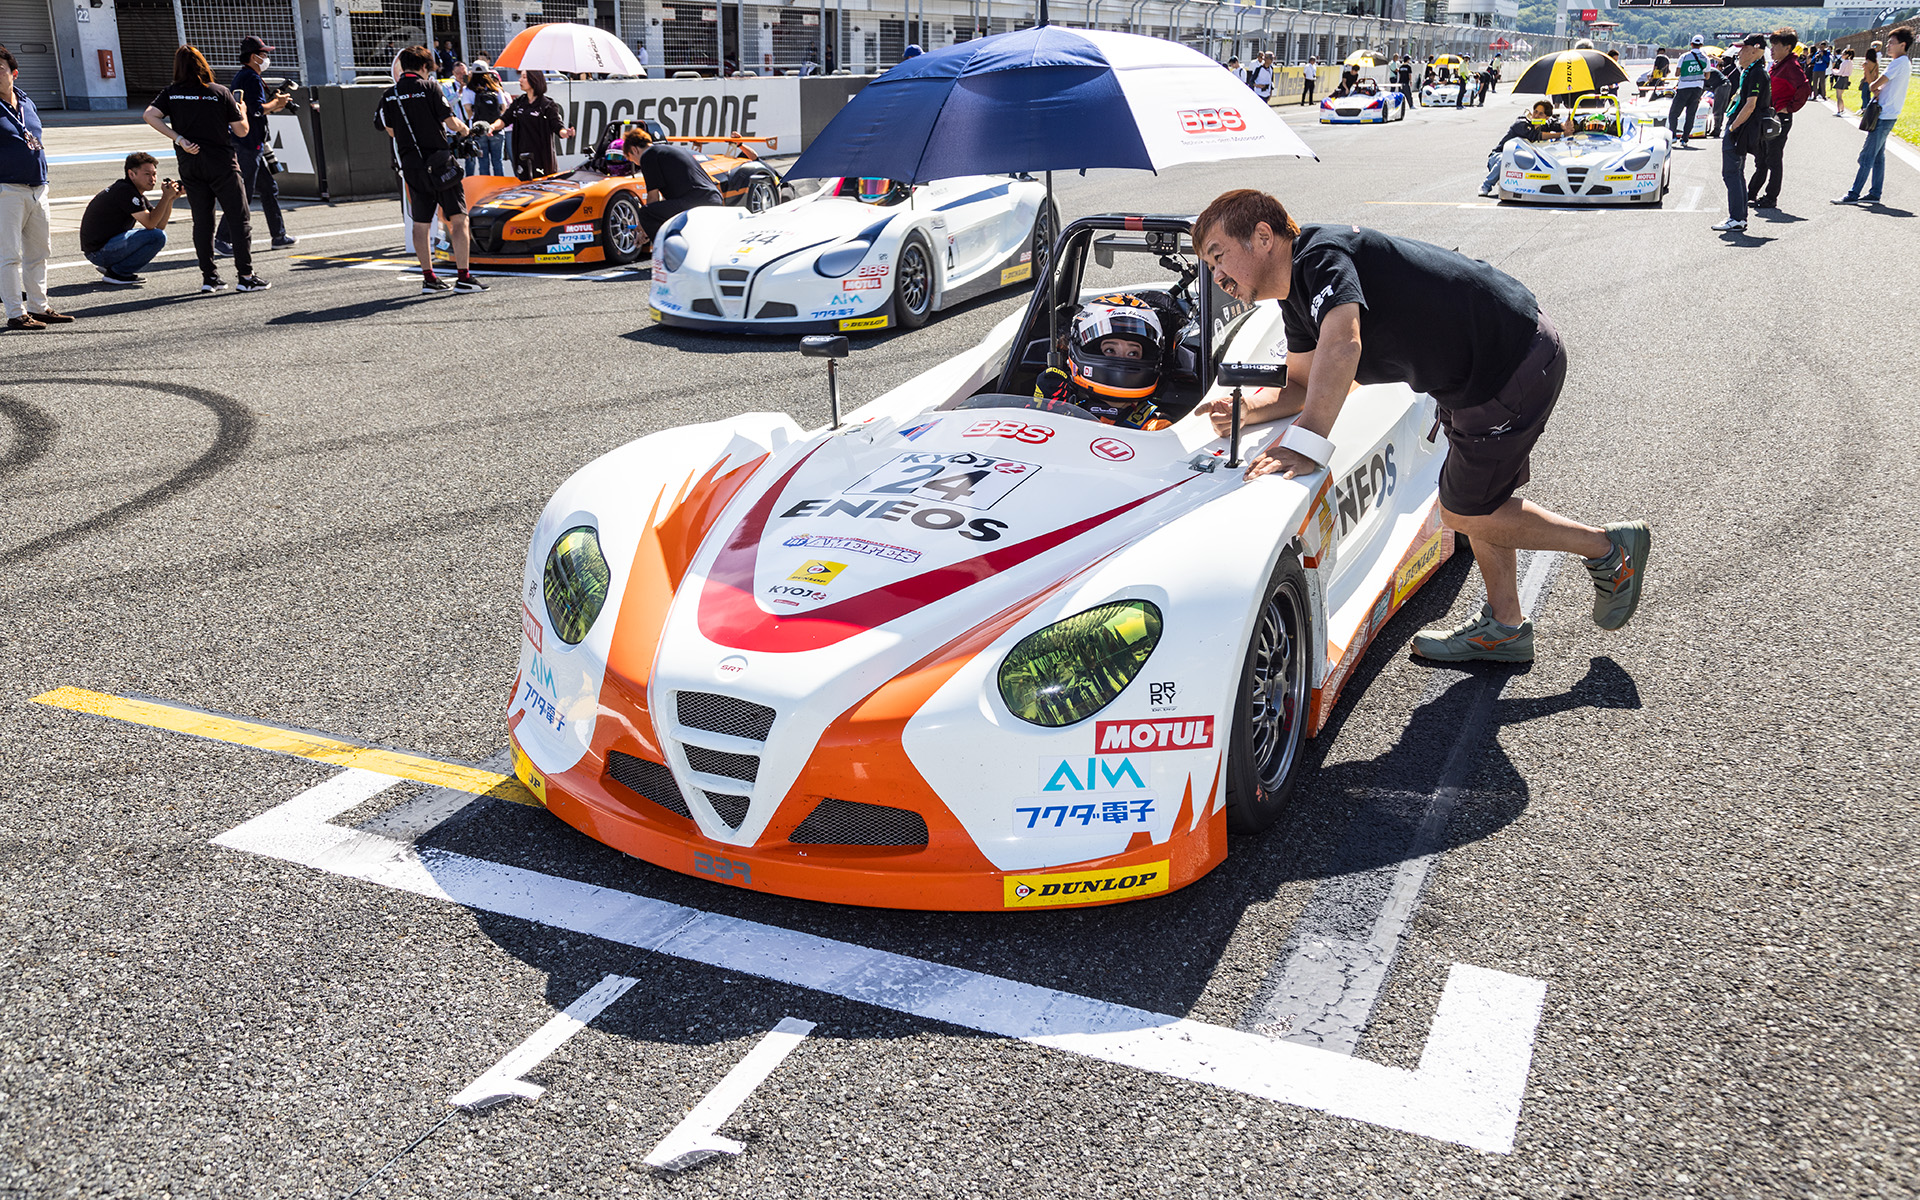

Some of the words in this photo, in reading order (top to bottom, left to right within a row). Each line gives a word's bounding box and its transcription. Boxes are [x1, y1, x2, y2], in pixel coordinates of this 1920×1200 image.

[77, 10, 89, 21] 22
[1687, 64, 1701, 73] 098
[1177, 107, 1246, 134] BBS
[566, 224, 593, 232] MOTUL
[740, 234, 779, 245] 44
[858, 264, 889, 277] BBS
[844, 279, 880, 289] MOTUL
[850, 319, 885, 327] DUNLOP
[962, 420, 1055, 444] BBS
[870, 464, 991, 502] 24
[1337, 443, 1397, 540] NEOS
[779, 499, 1009, 542] ENEOS
[1403, 541, 1439, 587] DUNLOP
[1100, 721, 1209, 750] MOTUL
[1016, 799, 1155, 829] フクダ電子
[1038, 872, 1158, 897] DUNLOP
